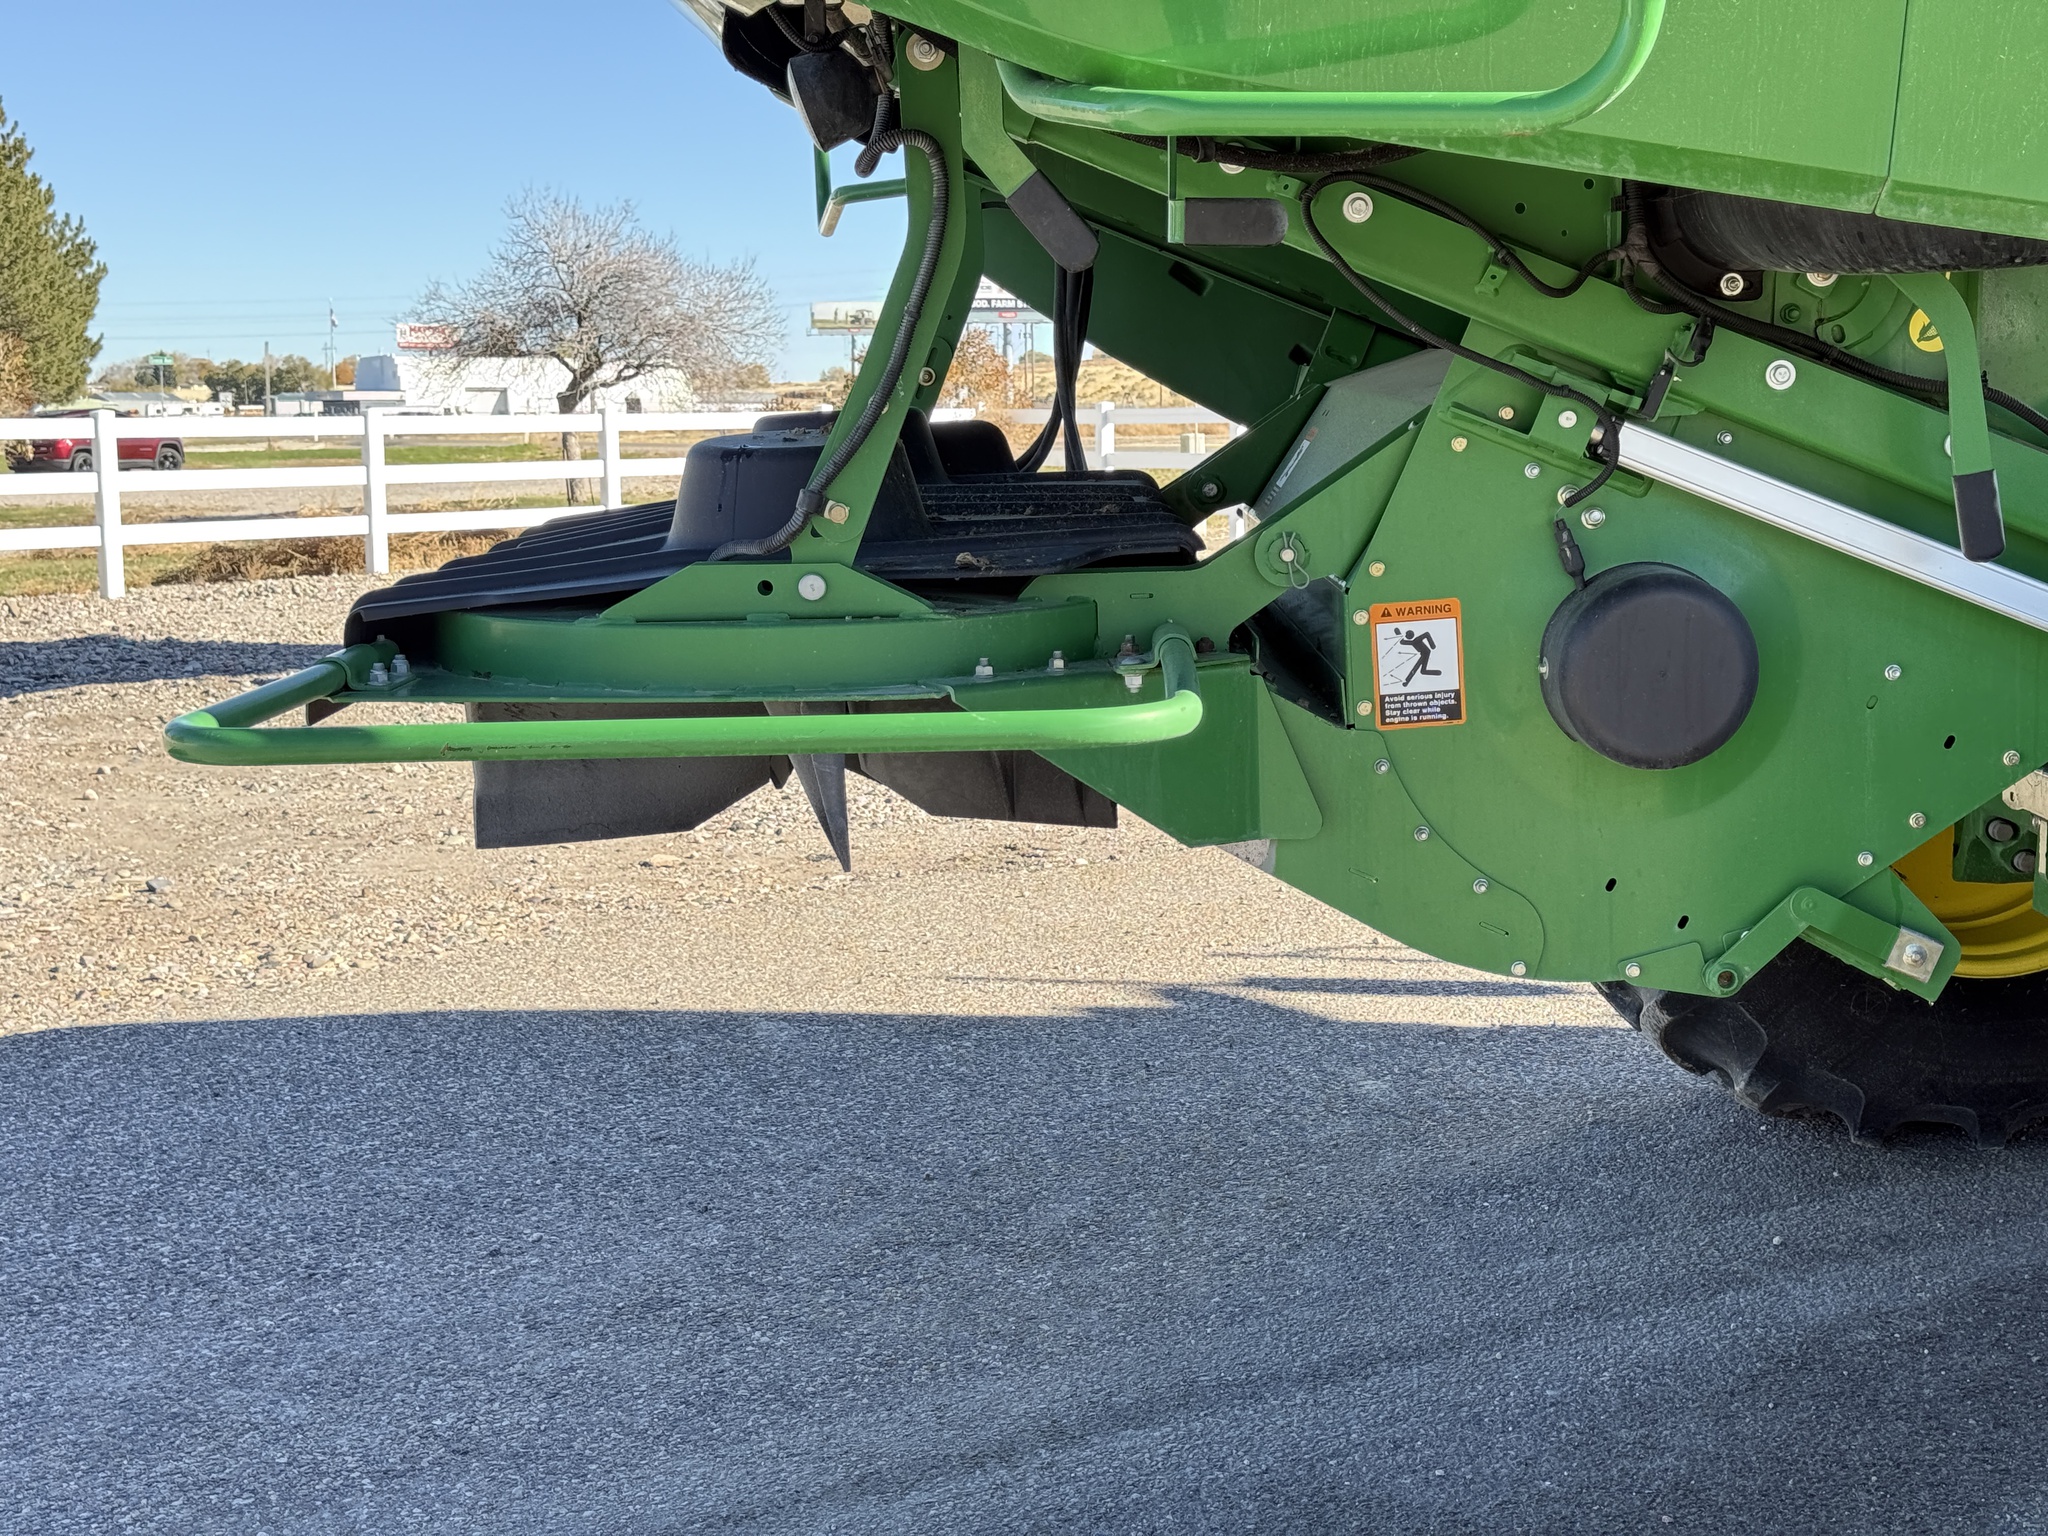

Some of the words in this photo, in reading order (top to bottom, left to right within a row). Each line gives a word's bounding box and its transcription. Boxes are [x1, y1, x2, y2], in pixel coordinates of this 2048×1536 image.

[991, 299, 1016, 308] FARM
[1395, 603, 1452, 617] WARNING
[1406, 693, 1433, 701] serious
[1434, 692, 1455, 700] injury
[1429, 699, 1457, 707] objects.
[1422, 706, 1441, 714] while
[1385, 716, 1409, 724] engine
[1419, 713, 1449, 721] running.
